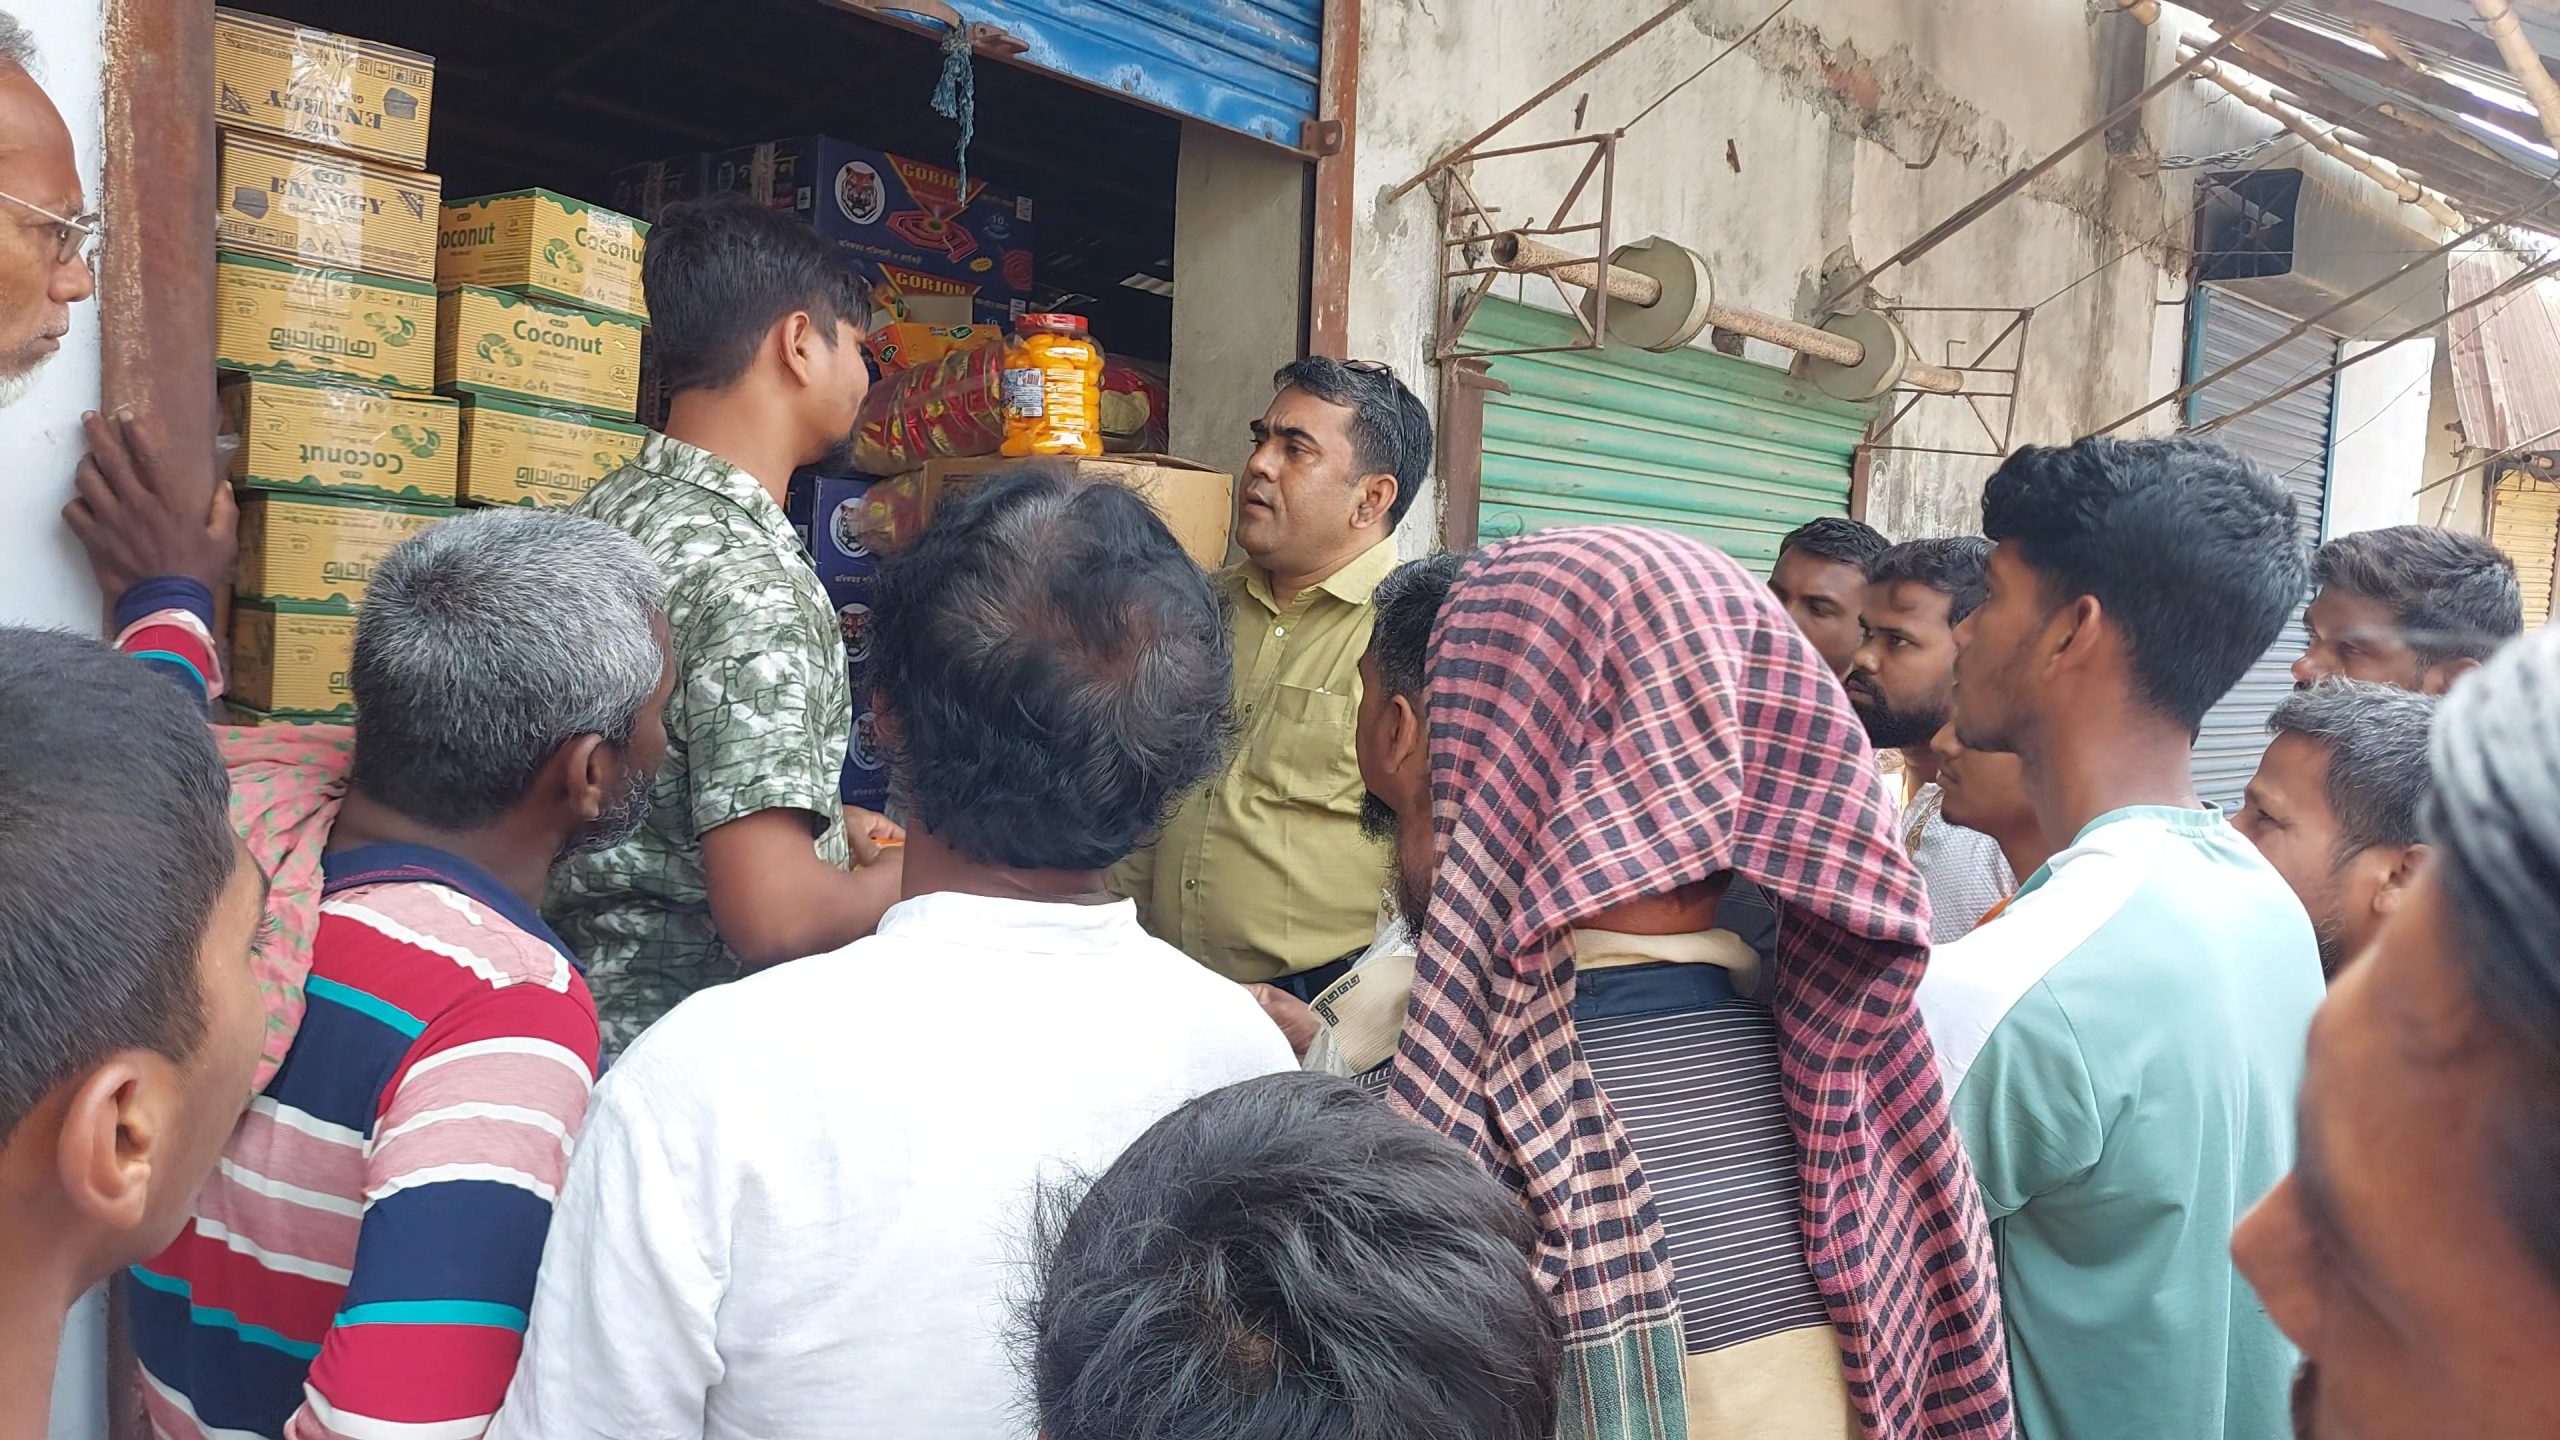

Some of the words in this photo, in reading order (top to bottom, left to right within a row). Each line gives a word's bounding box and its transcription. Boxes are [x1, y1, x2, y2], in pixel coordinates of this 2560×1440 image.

[263, 89, 382, 130] ENERGY
[270, 176, 385, 215] ENGY
[436, 221, 496, 251] oconut
[992, 214, 1005, 226] 10
[575, 226, 642, 264] Coconu
[895, 271, 967, 296] GORJON
[267, 327, 377, 361] কোকোনাট
[513, 319, 603, 356] Coconut
[614, 367, 626, 376] 24
[298, 444, 404, 475] Coconut
